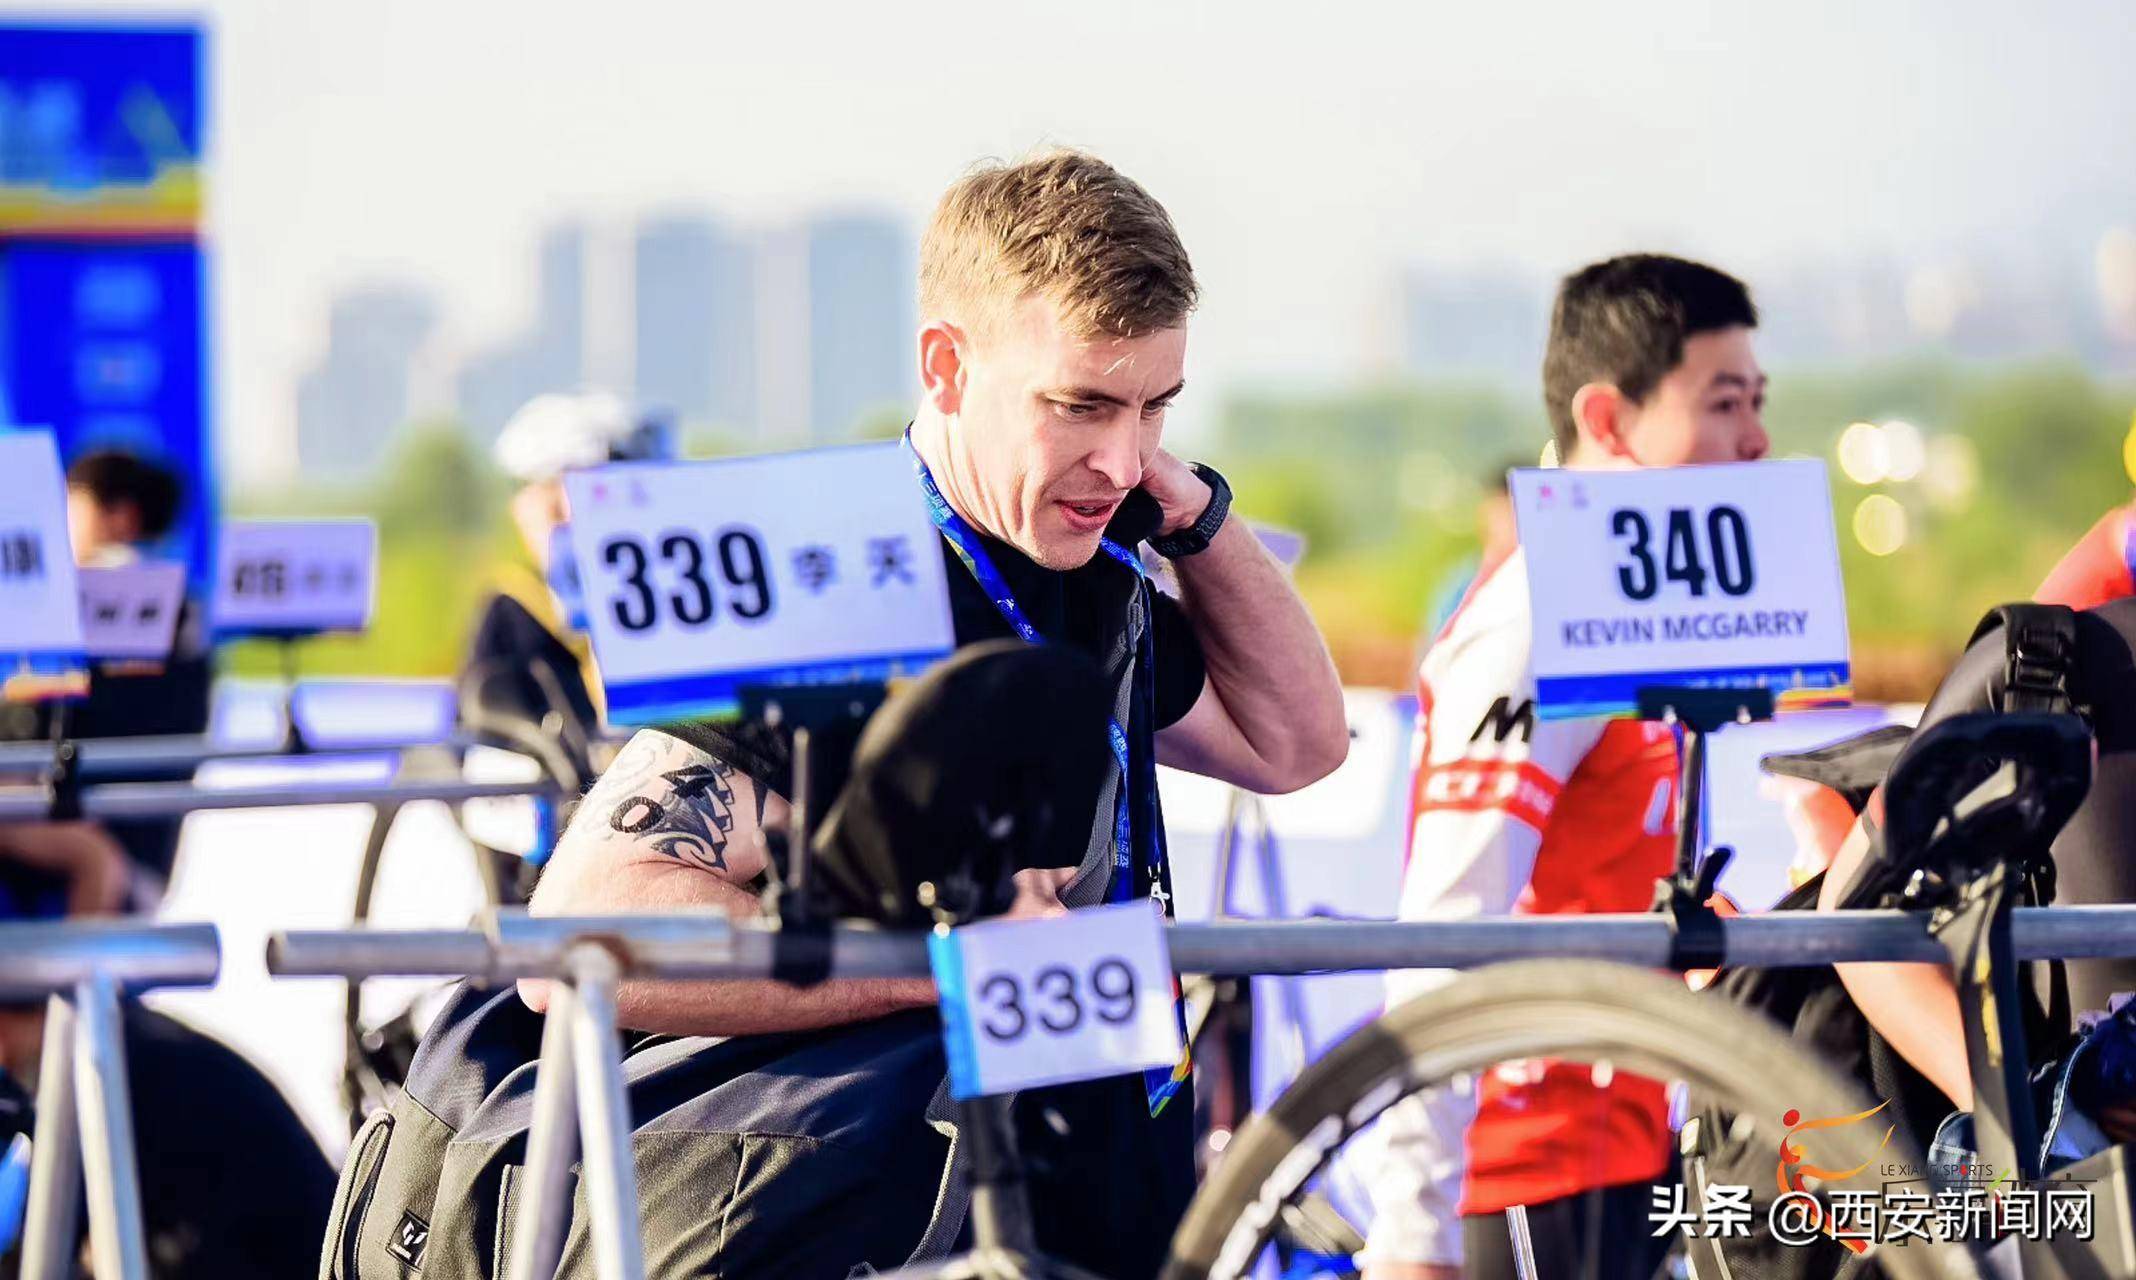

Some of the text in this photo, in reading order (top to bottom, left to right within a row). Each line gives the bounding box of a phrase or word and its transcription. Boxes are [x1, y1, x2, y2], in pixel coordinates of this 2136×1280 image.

[604, 531, 771, 630] 339
[1613, 505, 1754, 600] 340
[1562, 610, 1809, 647] KEVIN MCGARRY
[978, 958, 1137, 1041] 339
